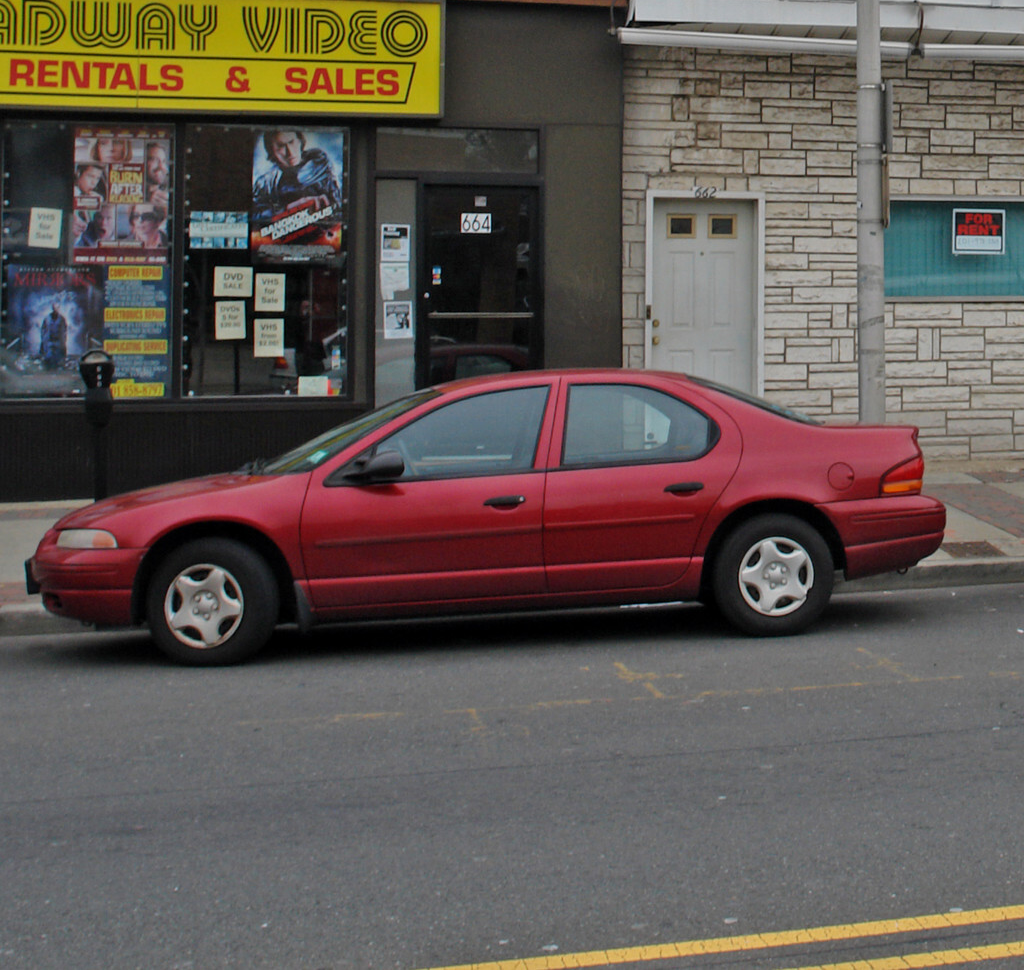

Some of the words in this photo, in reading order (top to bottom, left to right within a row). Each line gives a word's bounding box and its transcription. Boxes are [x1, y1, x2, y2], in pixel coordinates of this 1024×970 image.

[242, 6, 428, 57] VIDEO
[9, 58, 184, 91] RENTALS
[225, 66, 250, 93] &
[284, 68, 400, 96] SALES
[110, 170, 142, 184] BURN
[110, 183, 143, 195] AFTER
[695, 186, 716, 198] 662
[37, 213, 55, 221] VHS
[260, 208, 310, 237] BANGKOK
[271, 206, 333, 240] DANGEROUS
[965, 213, 992, 224] FOR
[39, 222, 51, 230] for
[463, 215, 490, 232] 664
[35, 232, 53, 240] Sale
[957, 224, 1000, 236] RENT
[223, 272, 243, 280] DVD
[262, 278, 278, 286] VHS
